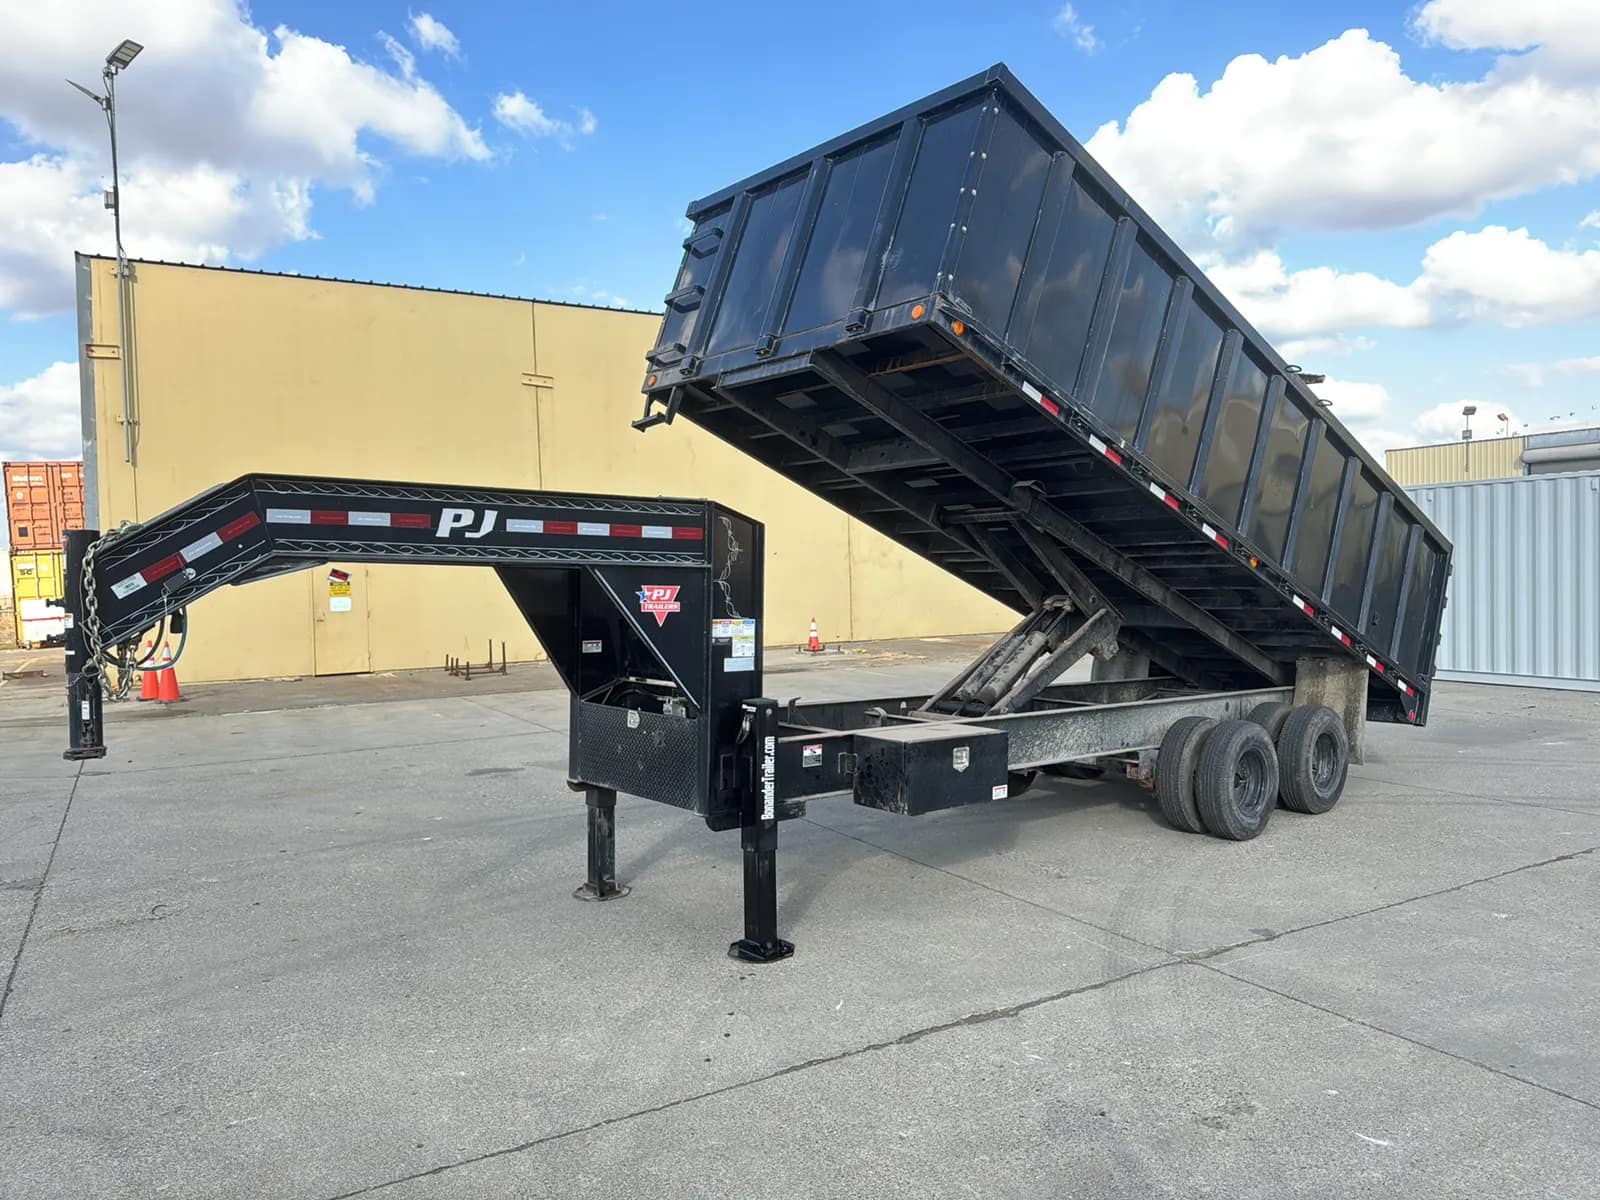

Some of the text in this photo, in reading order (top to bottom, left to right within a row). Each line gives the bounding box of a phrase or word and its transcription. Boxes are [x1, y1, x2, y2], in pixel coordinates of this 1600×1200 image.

[435, 508, 498, 538] PJ
[651, 589, 672, 600] PJ
[761, 736, 775, 820] BonanderTrailer.com
